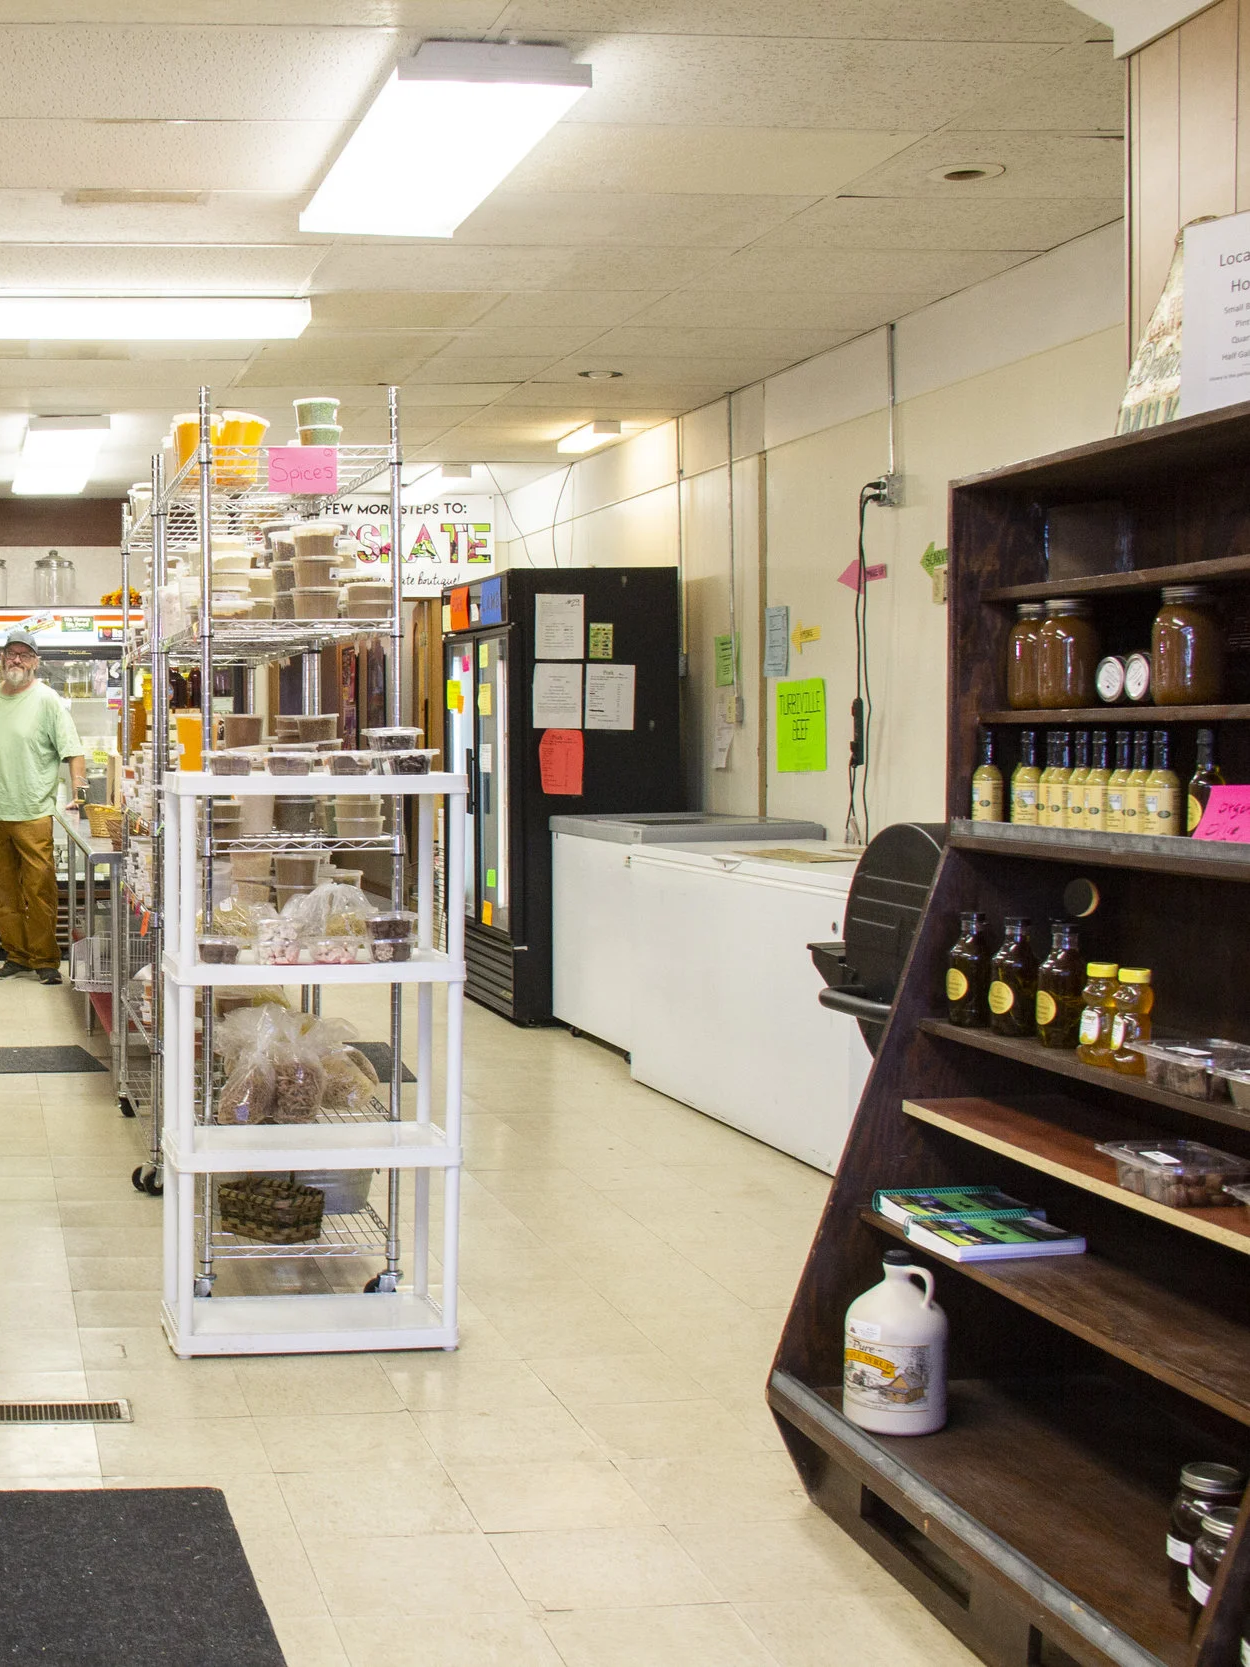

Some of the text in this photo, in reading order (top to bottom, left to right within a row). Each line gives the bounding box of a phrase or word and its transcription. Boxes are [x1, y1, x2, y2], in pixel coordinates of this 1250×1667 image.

[271, 457, 334, 487] Spices
[325, 503, 467, 515] FEW MOR STEPS TO:
[853, 1340, 875, 1353] Pure
